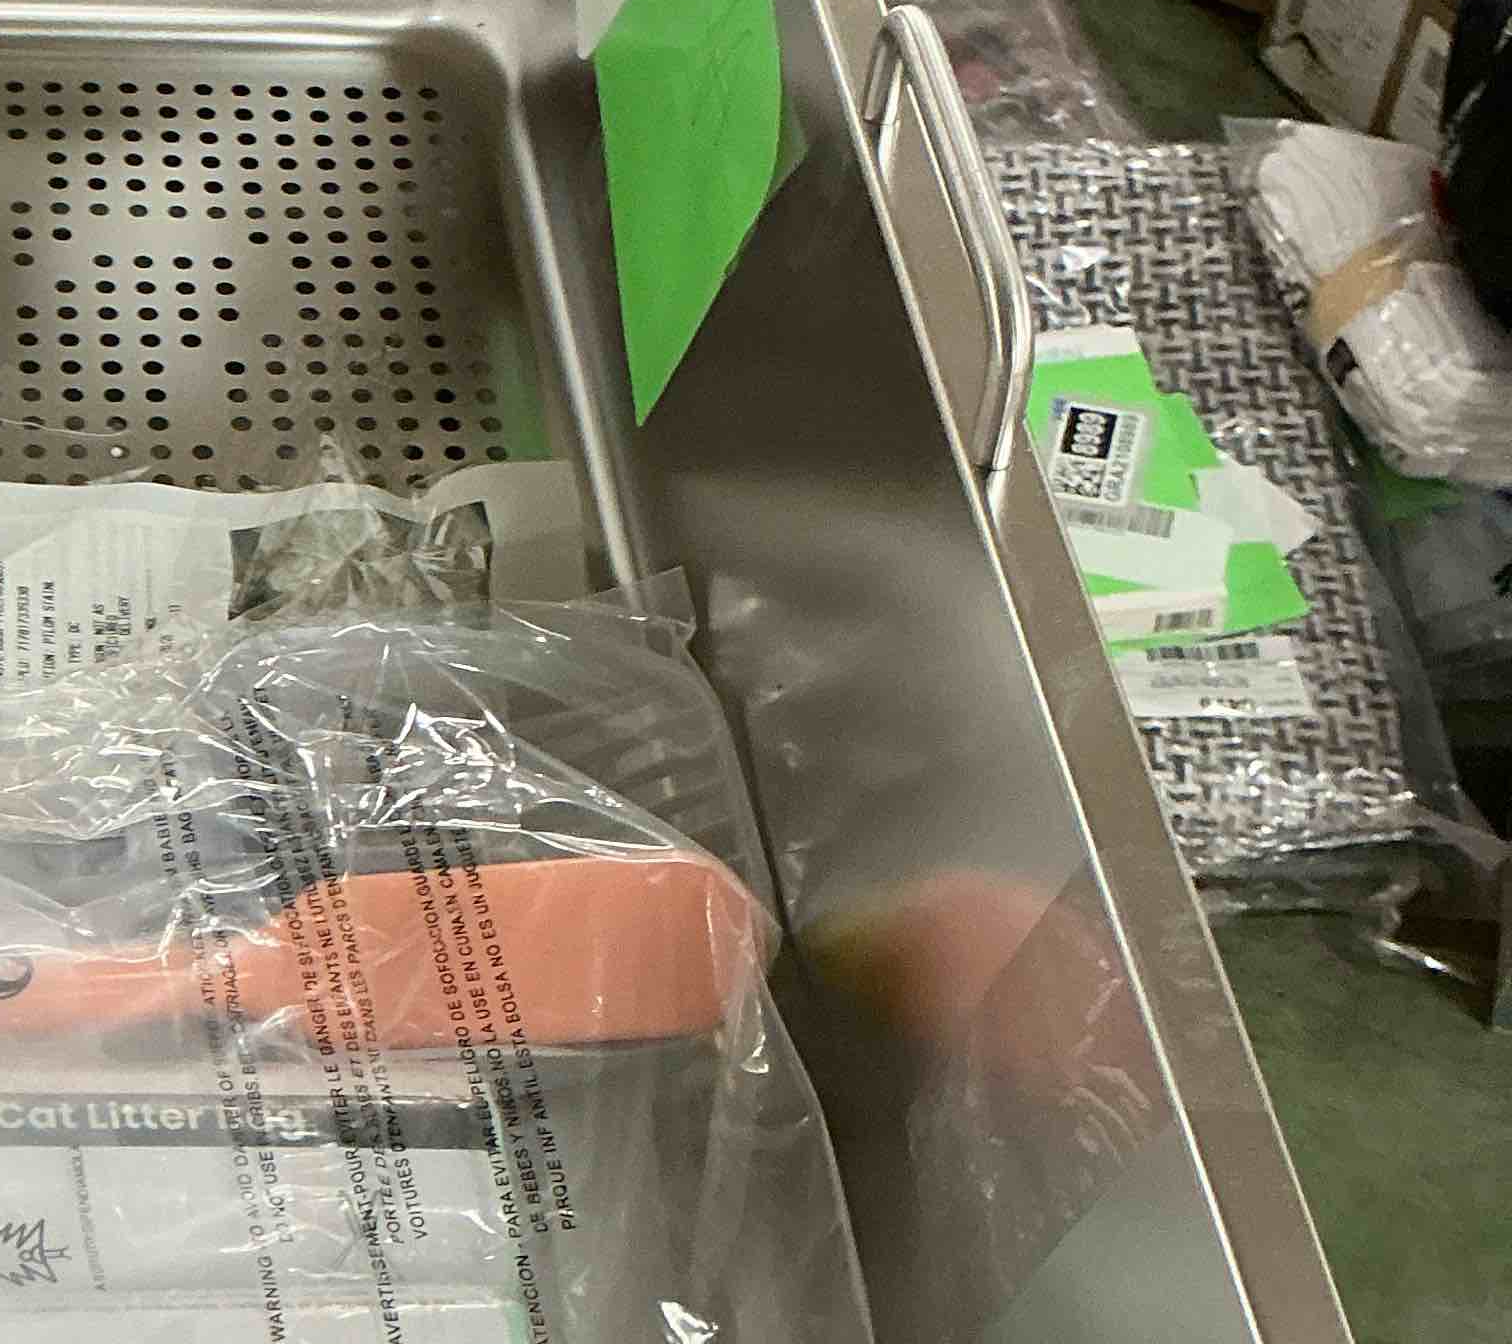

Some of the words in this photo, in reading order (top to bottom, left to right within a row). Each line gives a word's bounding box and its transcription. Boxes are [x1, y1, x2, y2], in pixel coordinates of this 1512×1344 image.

[401, 839, 432, 897] GUARDE
[470, 895, 491, 916] UN
[336, 913, 361, 965] PARCS
[477, 919, 497, 939] ES
[461, 960, 481, 982] EN
[486, 944, 506, 968] NO
[349, 968, 369, 994] LES
[448, 1001, 466, 1021] DE
[467, 987, 491, 1019] USE
[494, 974, 523, 1023] BOLSA
[338, 1020, 360, 1052] DES
[478, 1022, 498, 1043] LA
[505, 1028, 530, 1068] ESTA
[455, 1026, 486, 1096] PELIGRO
[88, 1100, 201, 1130] Litter
[258, 1151, 279, 1185] USE
[481, 1126, 509, 1187] EVITAR
[237, 1174, 260, 1219] AVOID
[393, 1158, 429, 1240] VOITURES
[499, 1192, 523, 1239] PARA
[257, 1255, 286, 1343] WARNING
